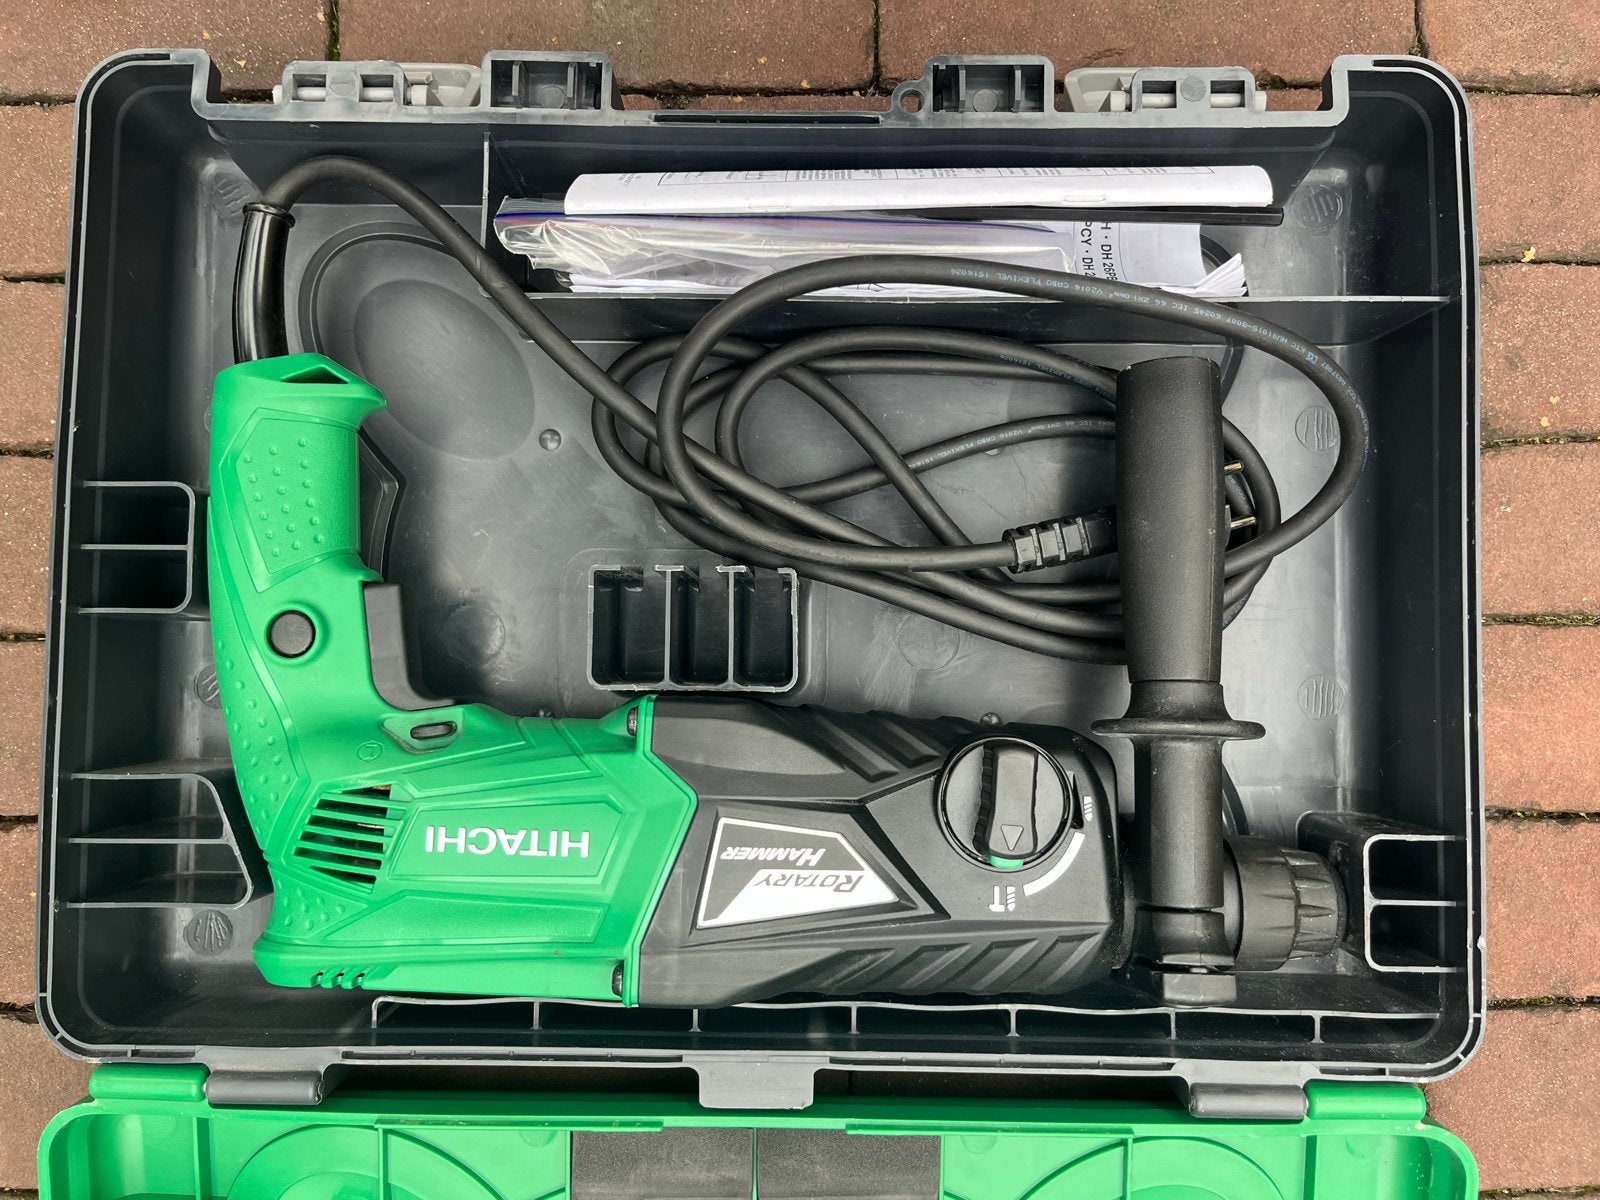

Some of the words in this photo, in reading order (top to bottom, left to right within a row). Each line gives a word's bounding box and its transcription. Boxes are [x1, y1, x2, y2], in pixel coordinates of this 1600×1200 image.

[1101, 244, 1113, 260] DH
[1082, 257, 1095, 271] DH
[996, 272, 1041, 285] FLEXIVEL
[1172, 302, 1188, 311] IEC
[425, 825, 590, 858] HITACHI
[720, 846, 826, 867] HAMMER
[755, 873, 864, 893] ROTARY
